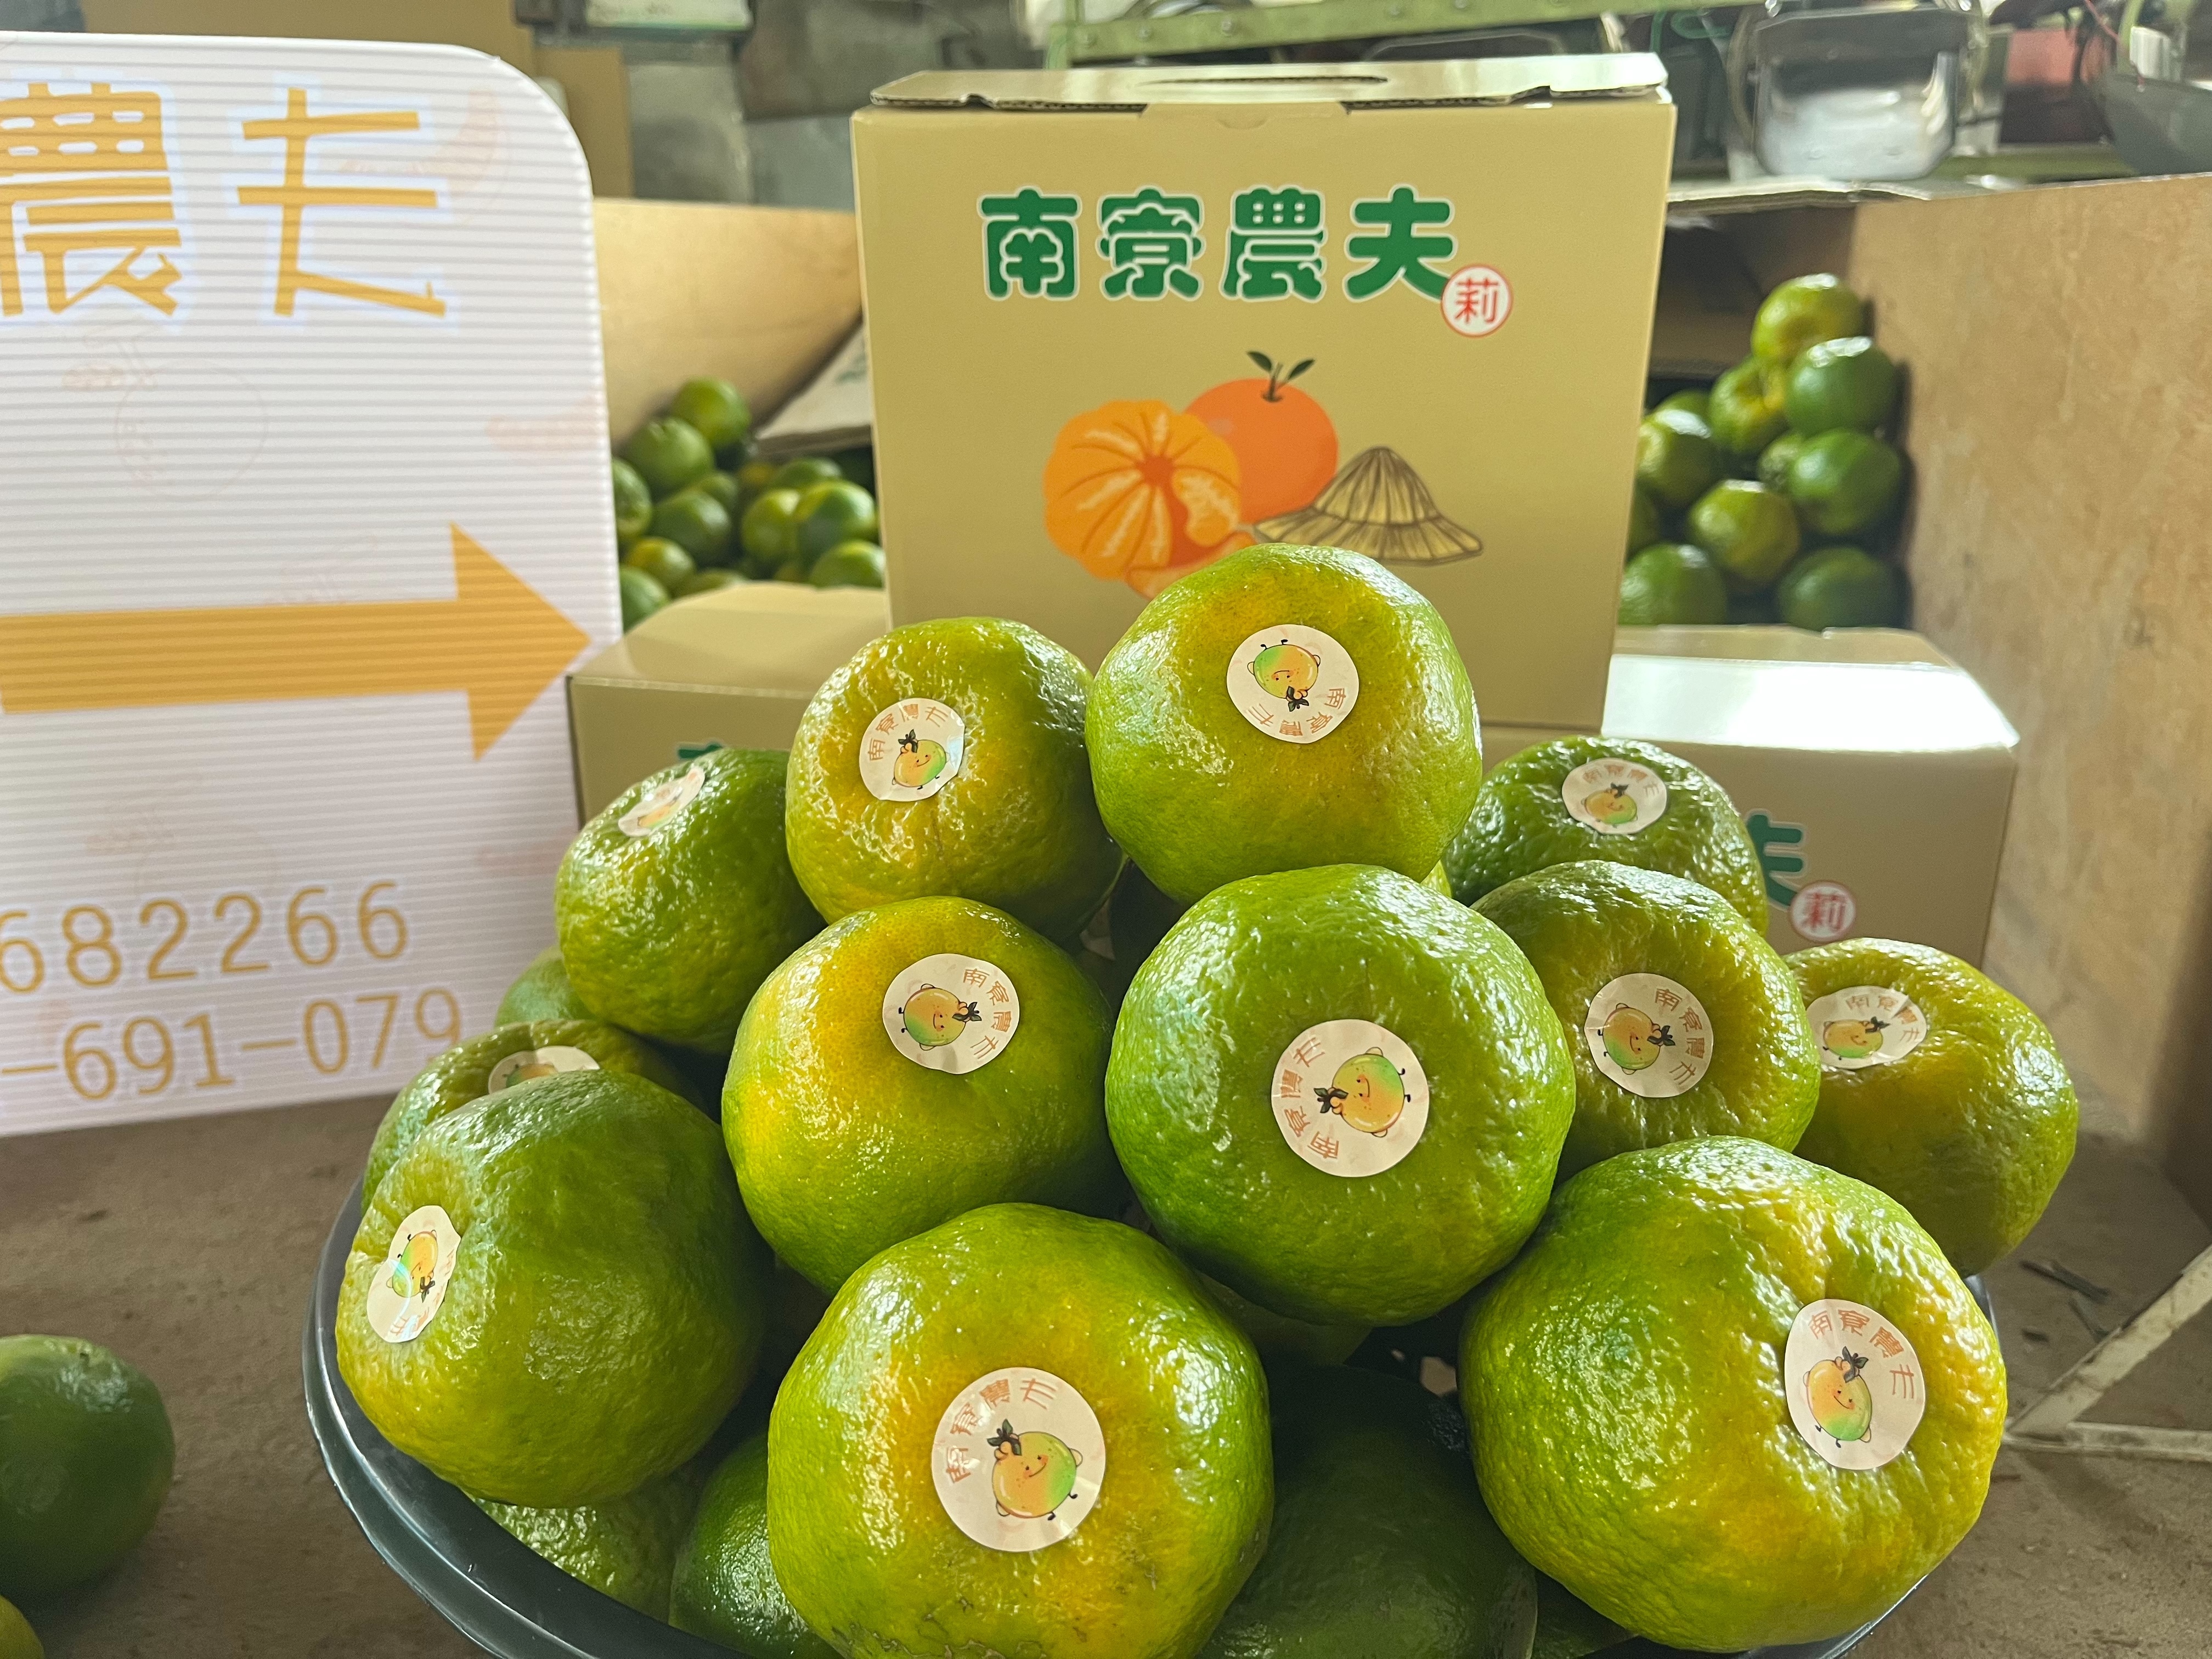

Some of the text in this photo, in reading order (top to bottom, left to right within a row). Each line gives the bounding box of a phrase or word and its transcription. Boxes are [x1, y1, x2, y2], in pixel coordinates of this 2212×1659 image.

[980, 185, 1458, 302] 南寮農夫
[1453, 276, 1500, 324] 莉
[1245, 687, 1346, 736] 南寮農夫
[0, 881, 408, 993] 682266
[963, 968, 1012, 1059] 南寮農夫
[1654, 988, 1706, 1085] 南寮農夫
[1808, 1309, 1915, 1400] 南寮農夫
